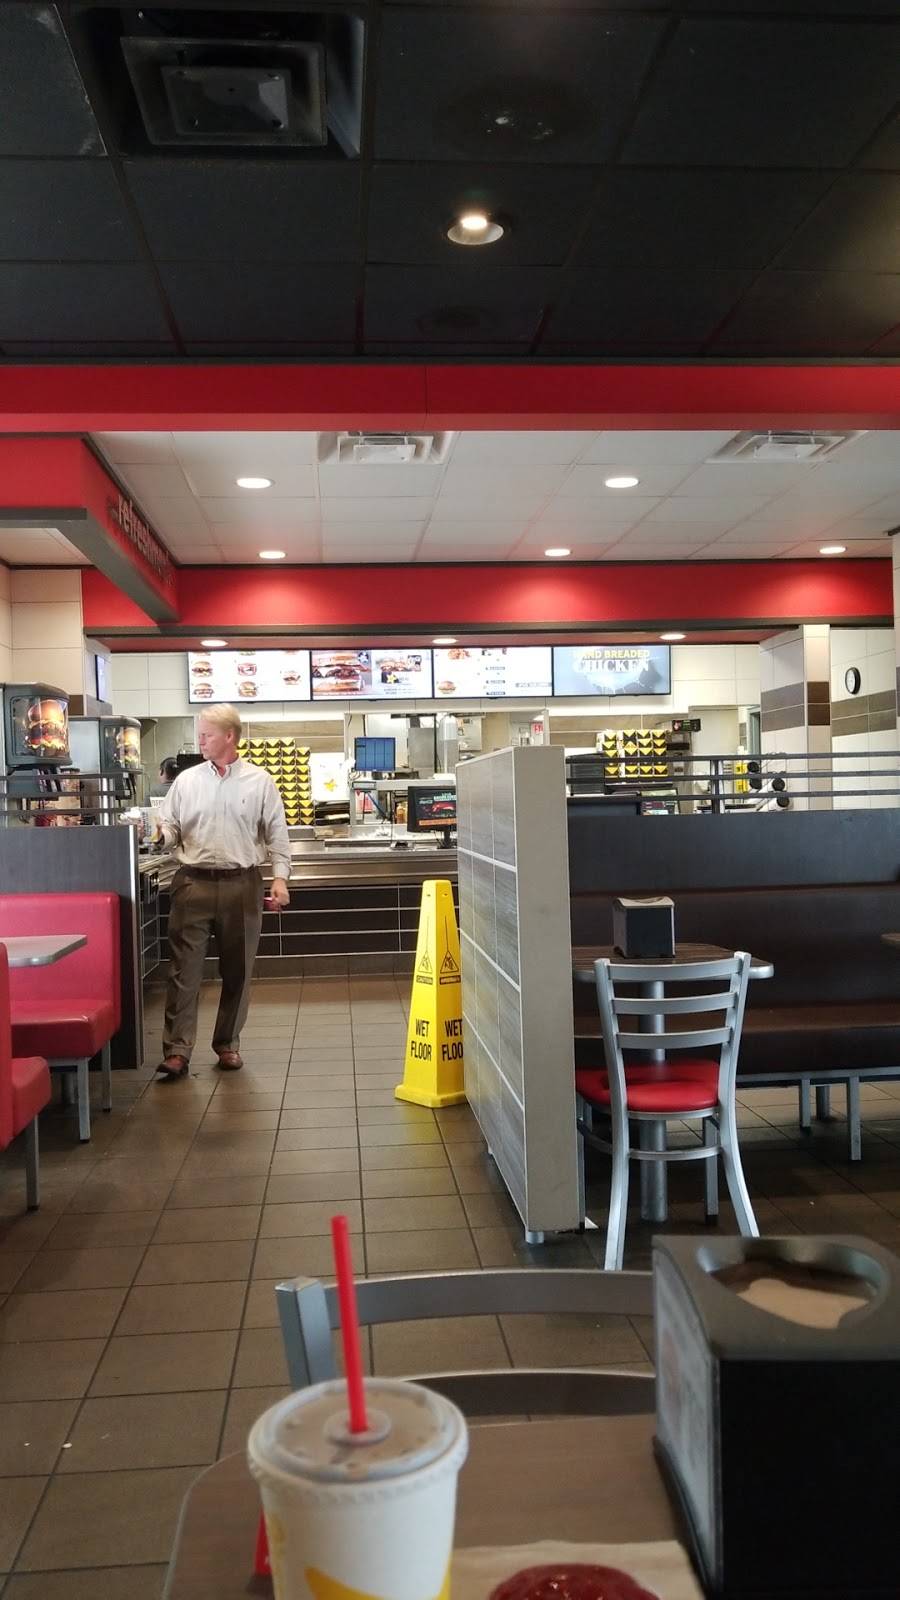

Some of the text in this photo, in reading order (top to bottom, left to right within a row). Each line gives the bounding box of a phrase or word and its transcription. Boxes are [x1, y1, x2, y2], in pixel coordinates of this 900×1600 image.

[604, 649, 650, 659] BREADED
[573, 659, 649, 673] CHICKEN
[416, 1018, 430, 1037] WET
[444, 1018, 463, 1037] WET
[411, 1040, 432, 1062] FLOOR
[442, 1041, 464, 1062] FLOO
